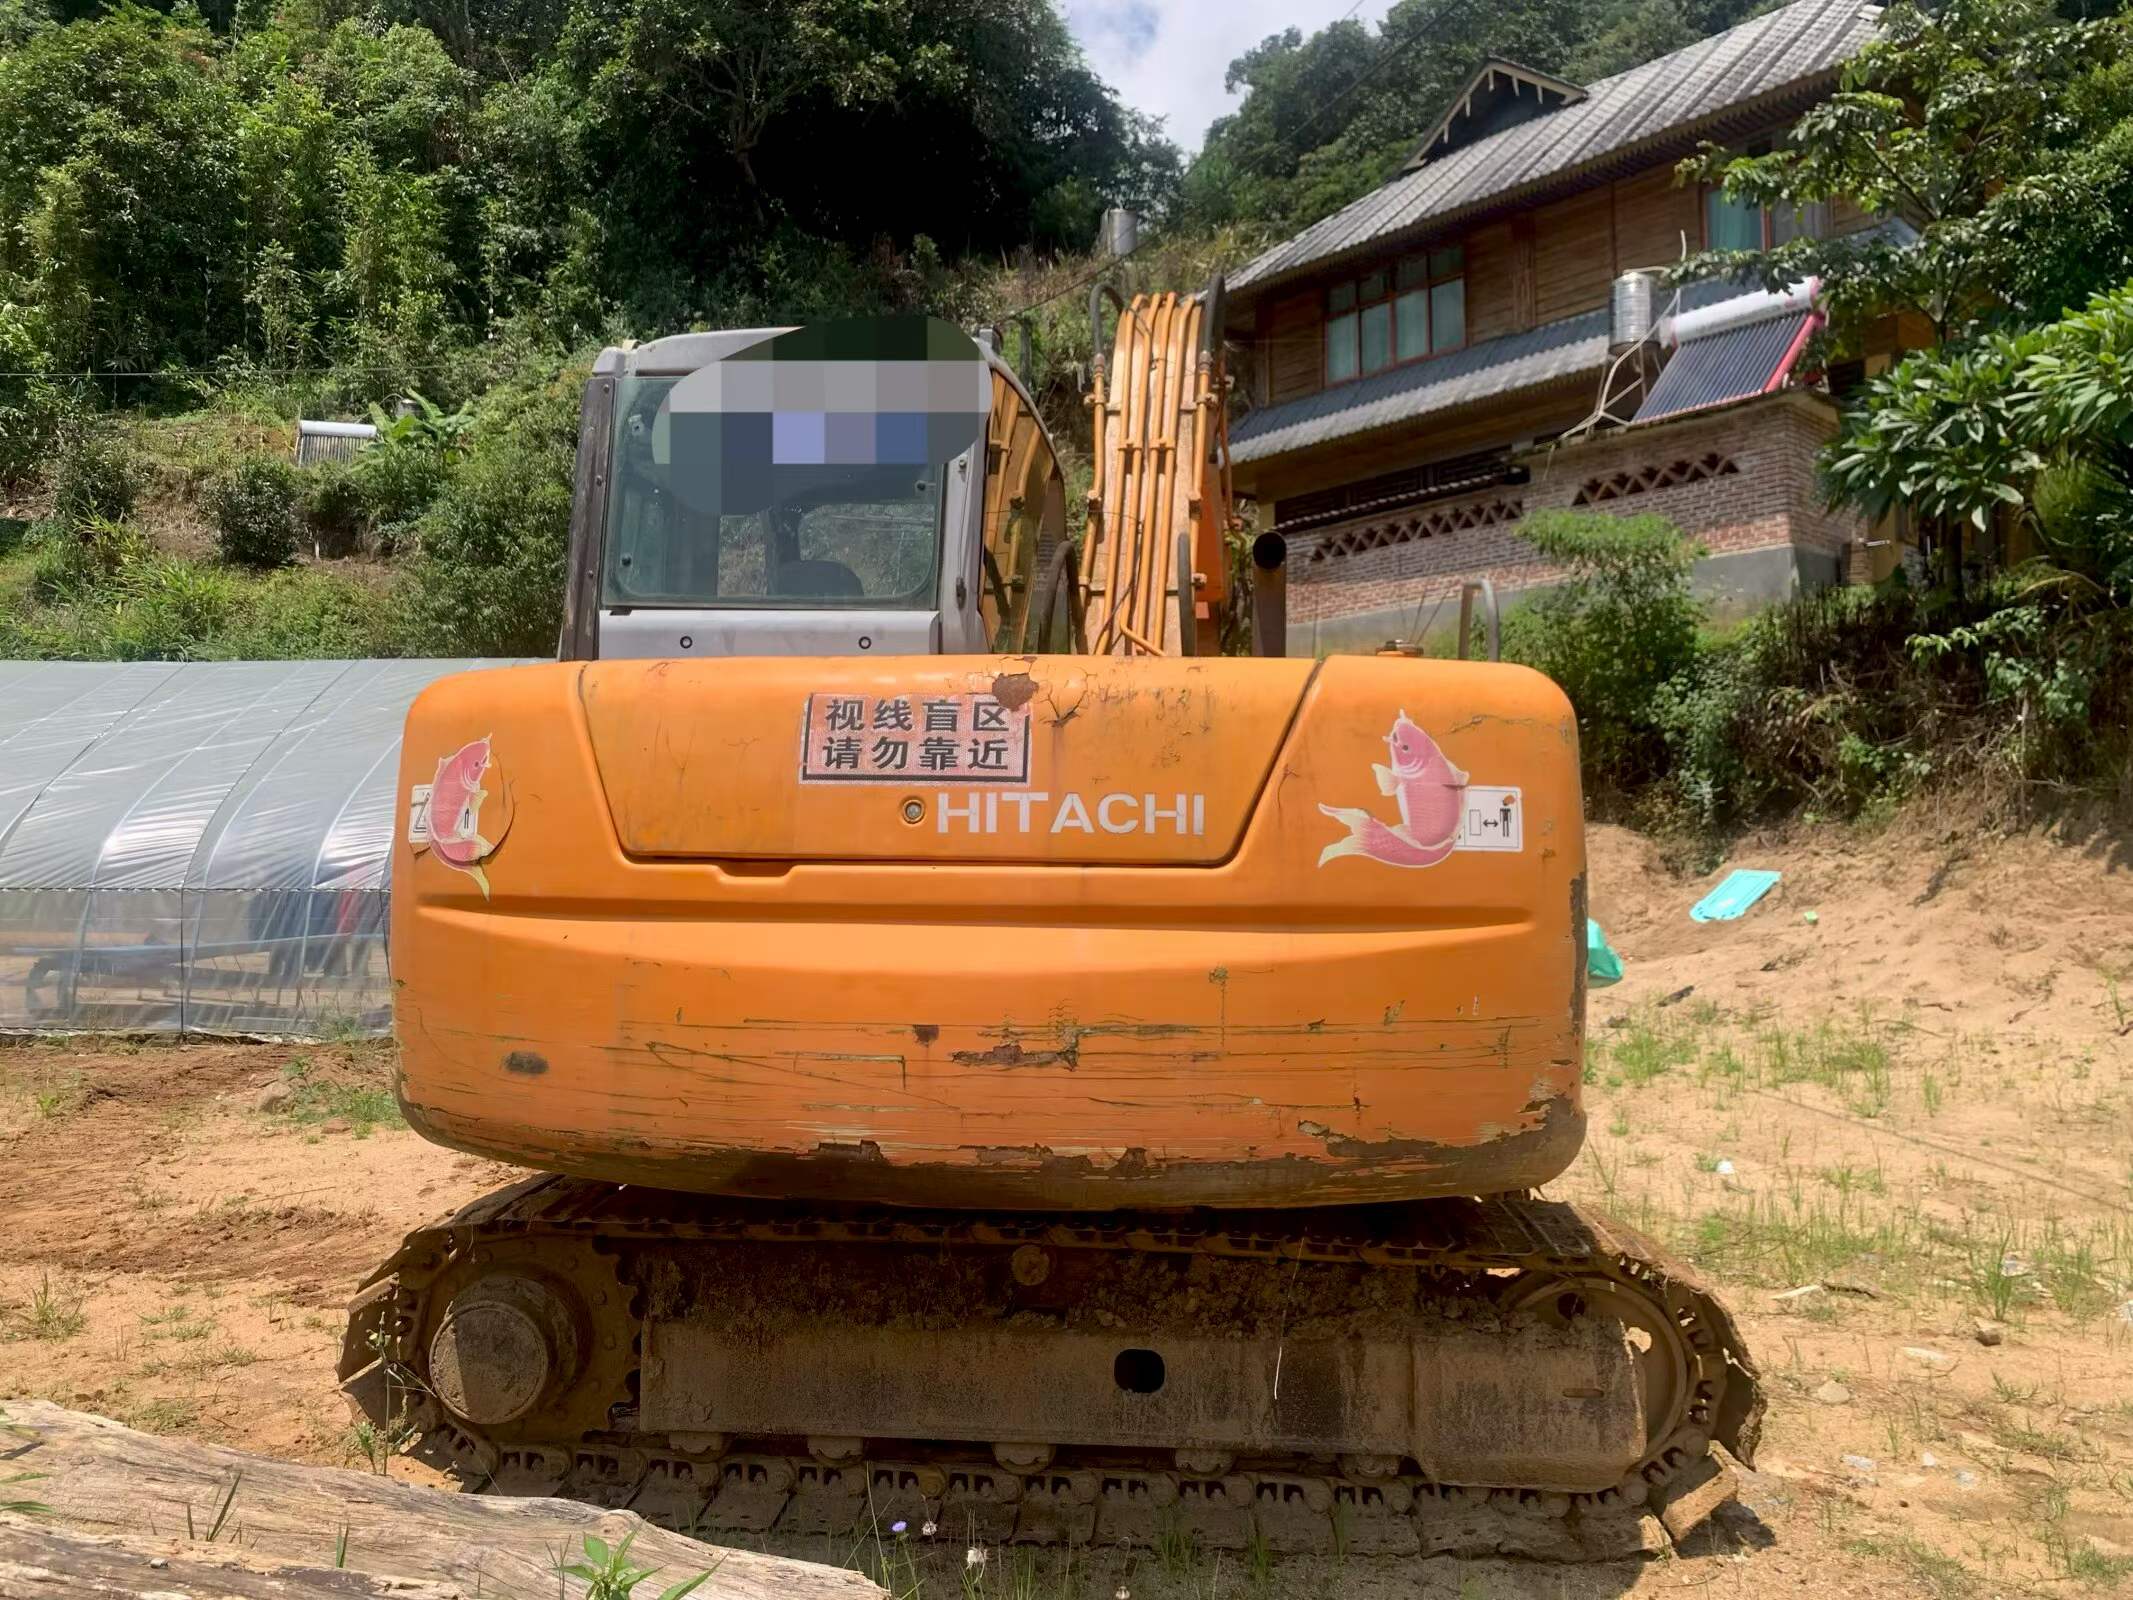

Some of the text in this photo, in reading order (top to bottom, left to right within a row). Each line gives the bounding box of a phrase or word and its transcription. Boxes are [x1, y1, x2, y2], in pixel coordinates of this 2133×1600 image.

[825, 699, 1010, 733] 视线盲区
[822, 736, 1009, 771] 请勿靠近
[936, 791, 1205, 835] HITACHI
